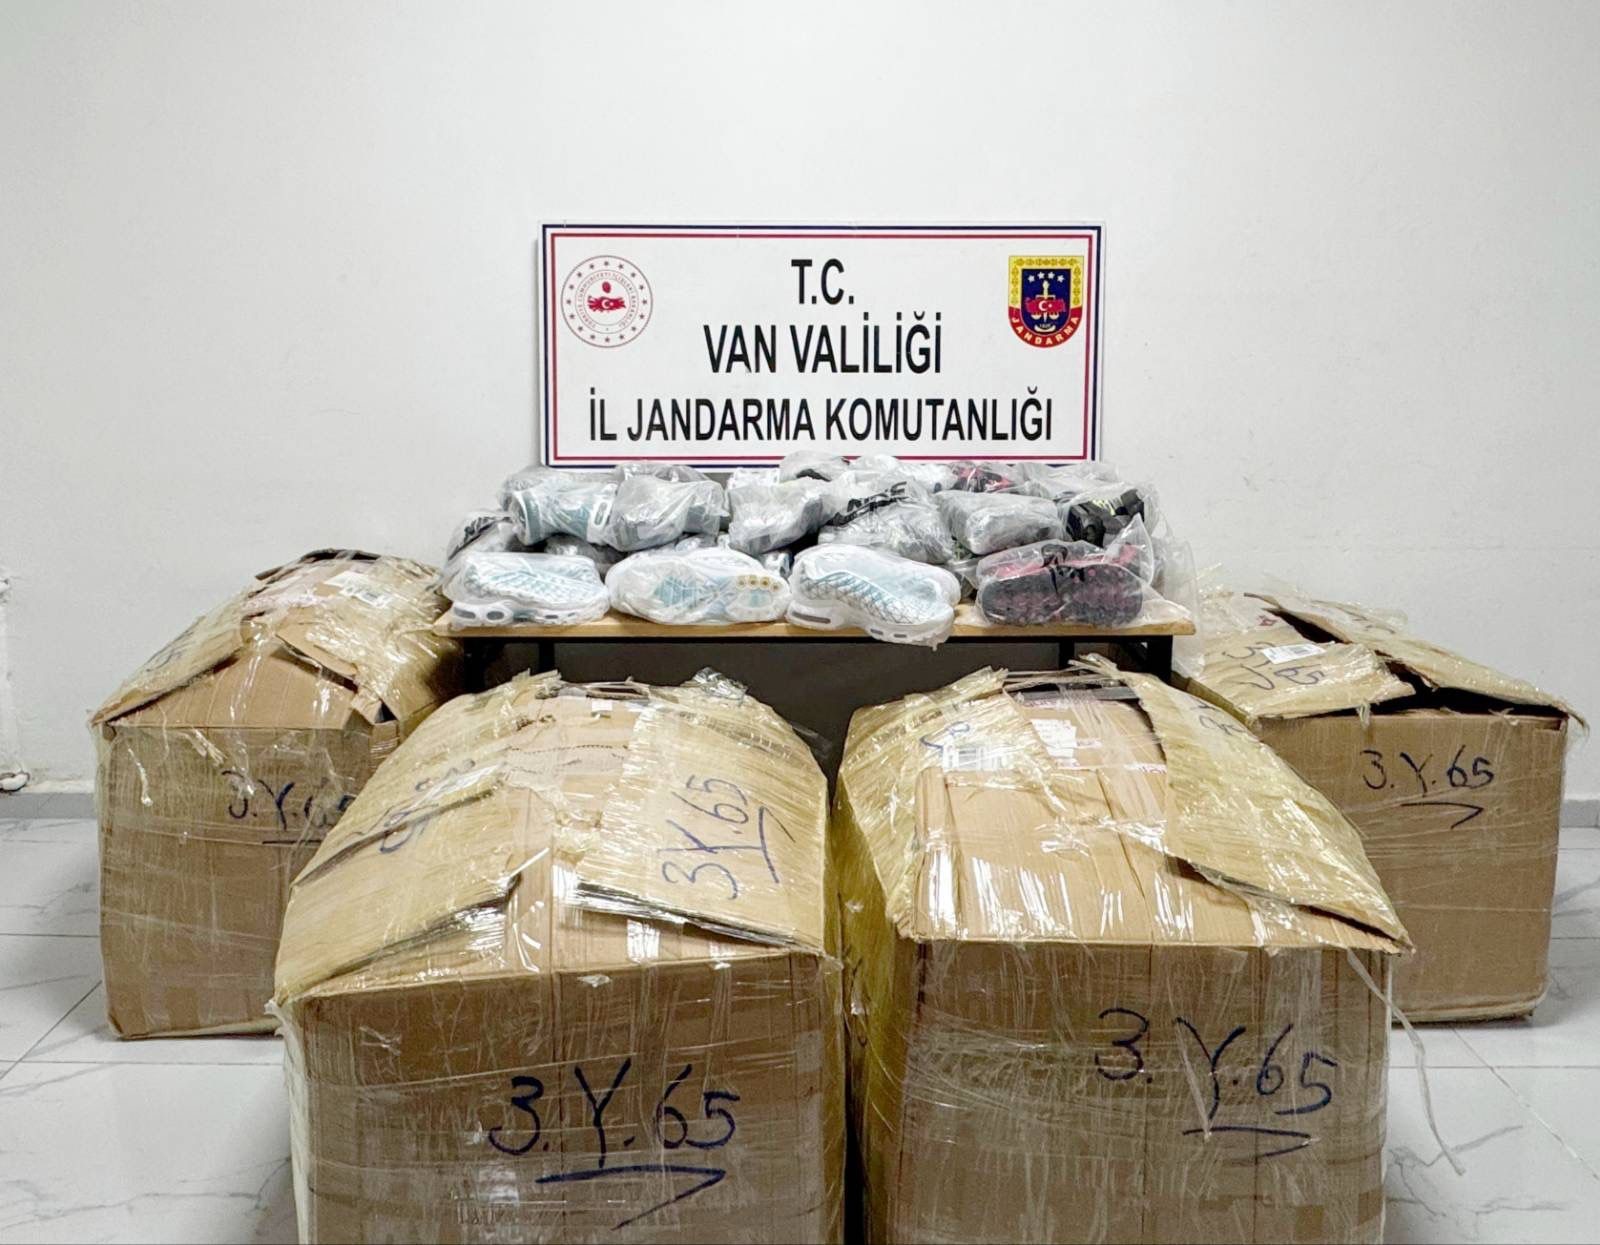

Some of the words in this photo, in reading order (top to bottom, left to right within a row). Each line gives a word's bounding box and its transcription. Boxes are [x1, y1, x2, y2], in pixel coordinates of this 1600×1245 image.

[791, 258, 854, 305] T.C.
[703, 324, 777, 373] VAN
[789, 311, 941, 374] VALİLİĞİ
[1011, 316, 1080, 345] JANDARMA
[590, 387, 617, 441] İL
[627, 398, 816, 442] JANDARMA
[826, 386, 1052, 441] KOMUTANLIĞI
